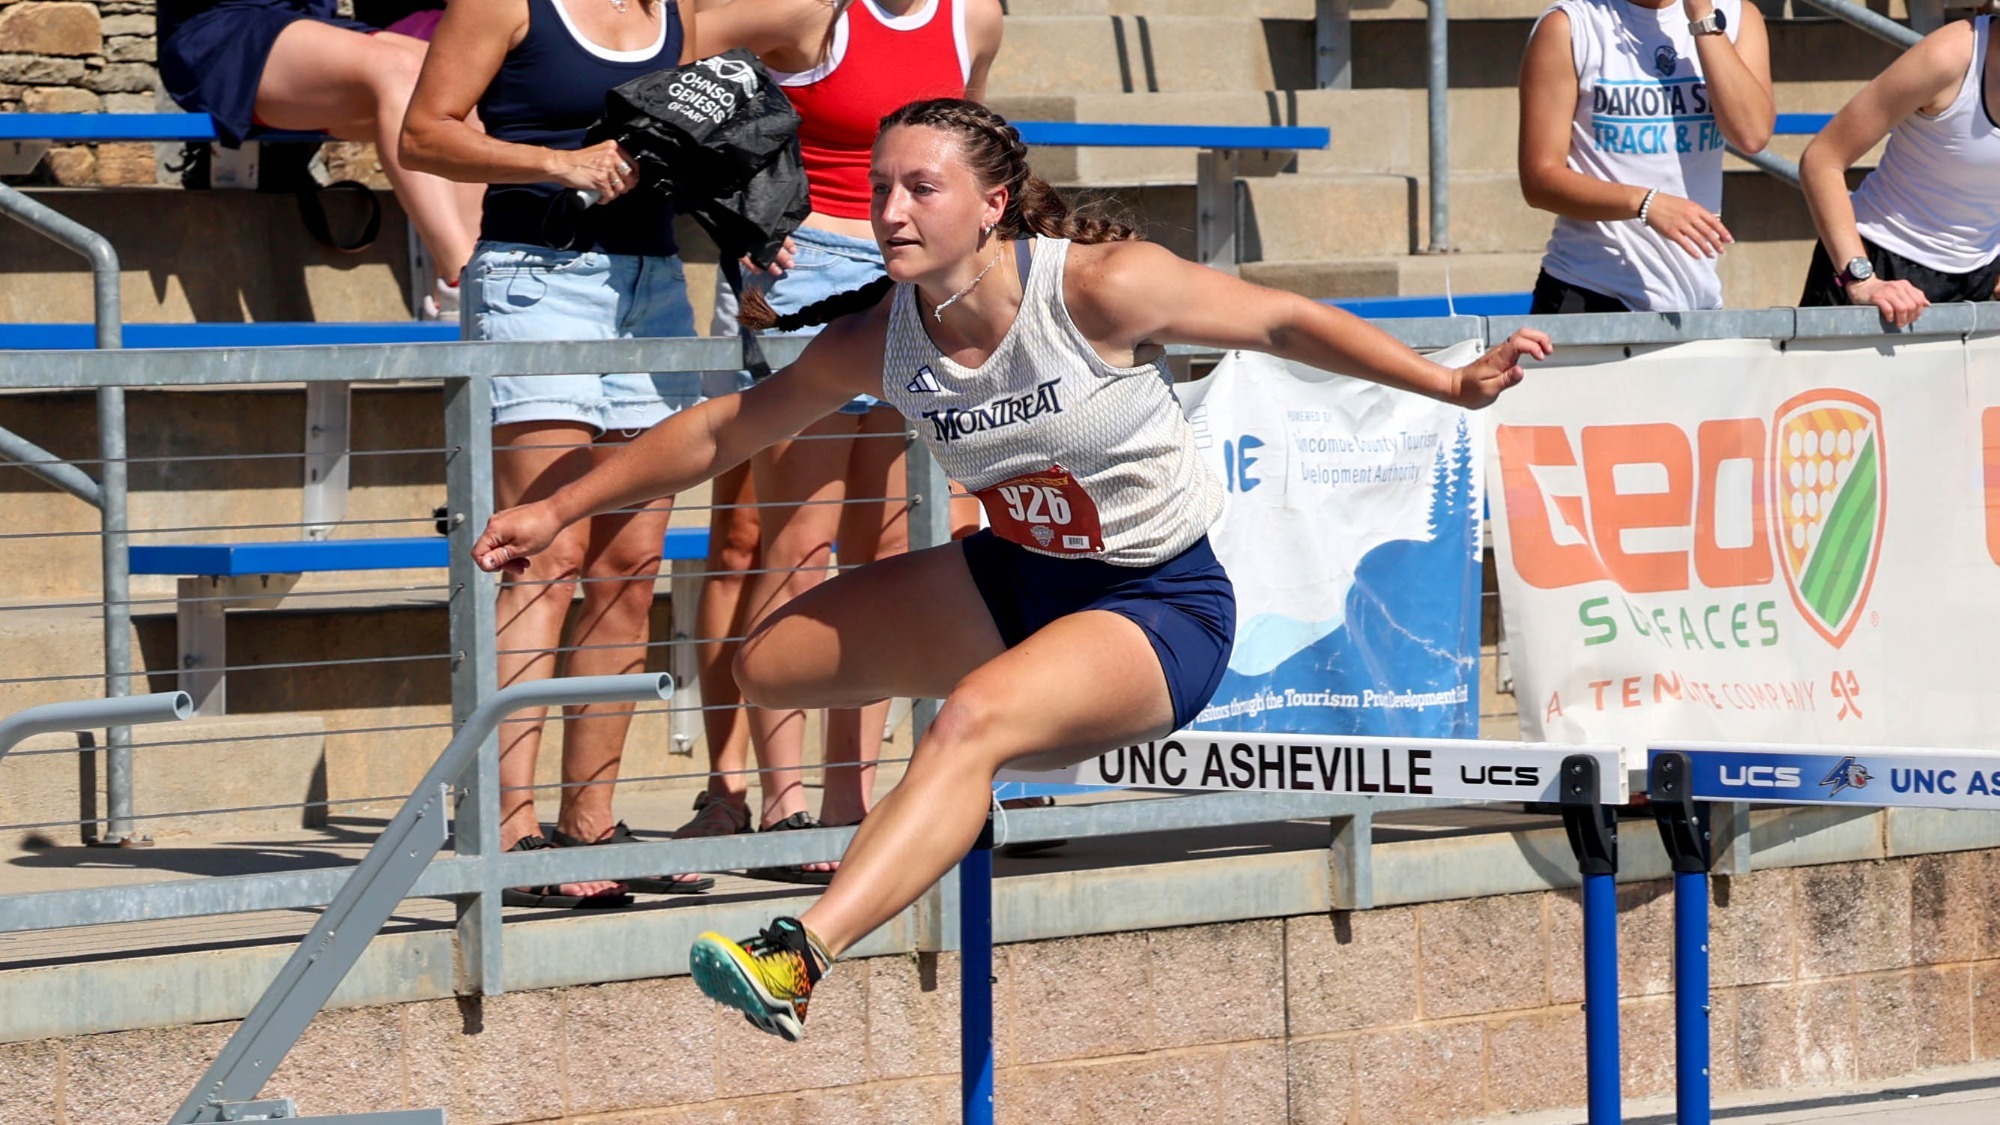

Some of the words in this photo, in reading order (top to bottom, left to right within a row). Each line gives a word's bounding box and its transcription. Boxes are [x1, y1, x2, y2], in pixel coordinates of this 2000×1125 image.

[668, 83, 725, 123] GENESIS
[668, 102, 684, 112] OF
[680, 105, 708, 123] CARY
[1593, 85, 1687, 116] DAKOTA
[1592, 122, 1668, 154] TRACK
[1676, 124, 1692, 152] &
[922, 377, 1064, 444] MONTREAT
[1399, 430, 1438, 450] Tourism
[997, 484, 1072, 525] 926
[1266, 690, 1283, 710] the
[1284, 688, 1359, 707] Tourism
[1546, 691, 1562, 724] A
[1722, 680, 1815, 712] COMPANY
[1098, 741, 1187, 786] UNC
[1200, 743, 1433, 795] ASHEVILLE
[1460, 765, 1539, 786] UCS
[1719, 765, 1801, 787] UCS
[1891, 768, 1957, 795] UNC
[1966, 770, 2000, 796] AS
